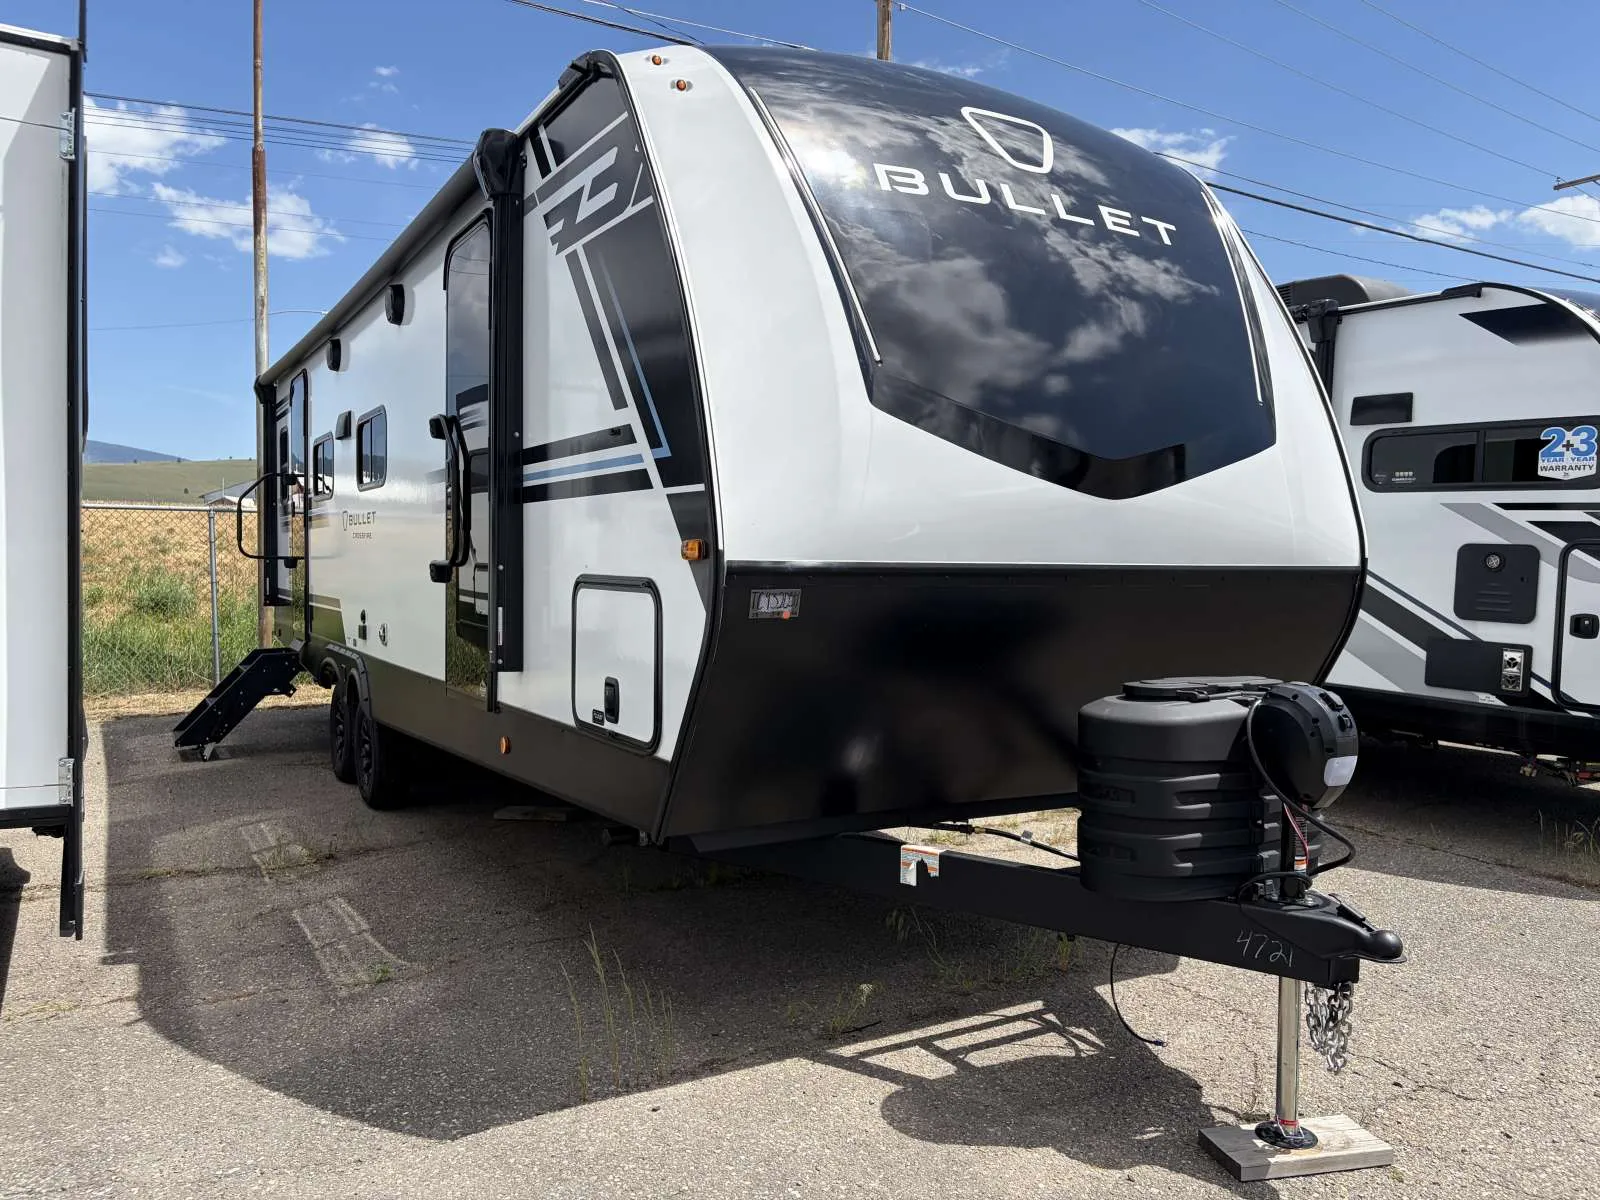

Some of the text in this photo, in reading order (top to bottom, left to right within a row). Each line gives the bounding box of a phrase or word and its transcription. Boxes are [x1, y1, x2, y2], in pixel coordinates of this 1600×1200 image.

[872, 163, 1177, 246] BULLET
[1540, 464, 1594, 472] WARRANTY
[348, 511, 377, 526] BULLET
[1236, 928, 1295, 968] 4721
